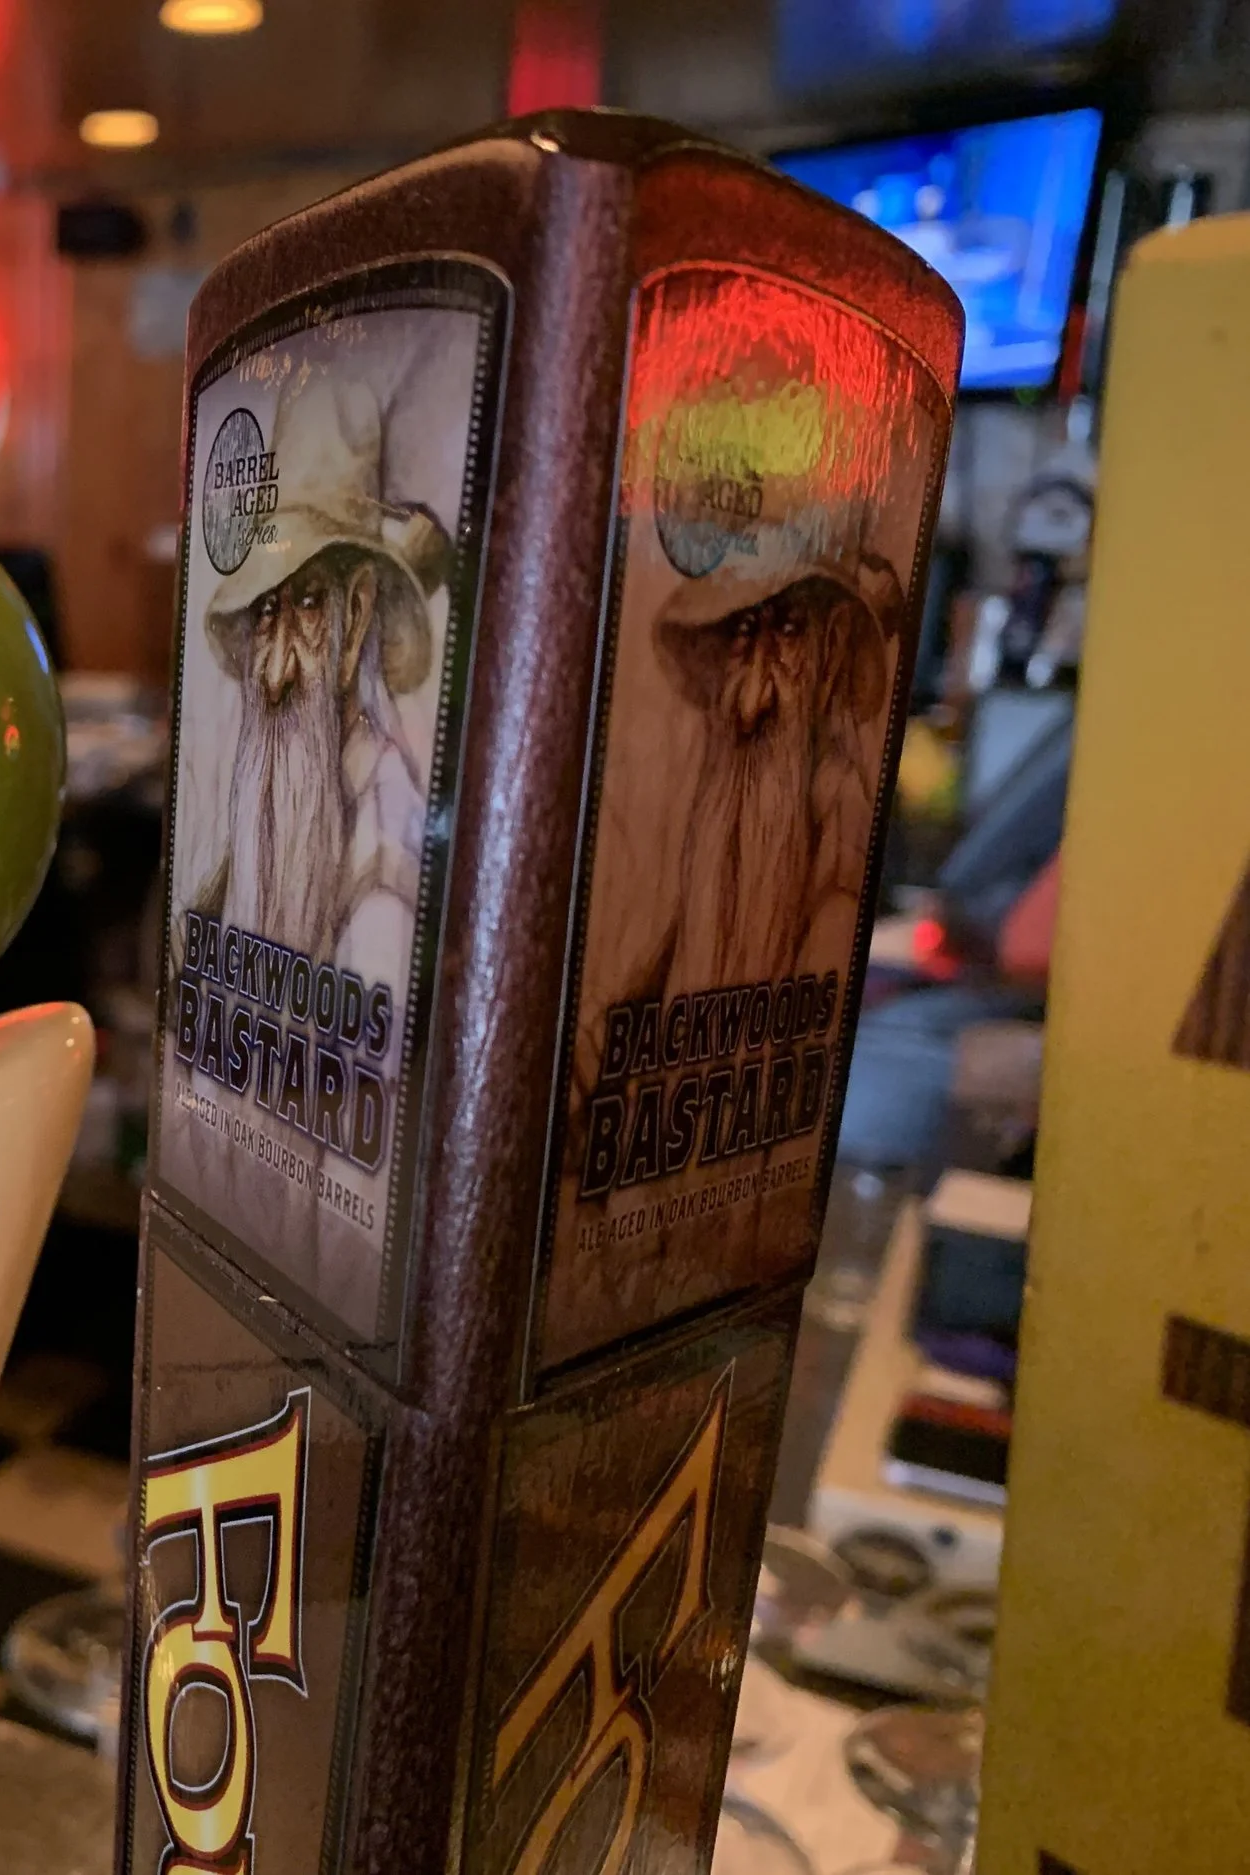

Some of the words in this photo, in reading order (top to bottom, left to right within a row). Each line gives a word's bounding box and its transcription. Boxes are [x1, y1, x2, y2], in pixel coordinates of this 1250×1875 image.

[214, 451, 280, 490] BARREL
[231, 483, 279, 518] AGED
[183, 910, 393, 1062] BACKWOODS
[601, 970, 838, 1081] BACKWOODS
[175, 979, 388, 1173] BASTARD
[579, 1048, 829, 1199] BASTARD
[220, 1107, 231, 1138] IN
[233, 1117, 256, 1153] OAK
[258, 1133, 314, 1190] BOURBON
[317, 1171, 375, 1230] BARRELS
[607, 1207, 646, 1244] AGED
[649, 1201, 666, 1229] IN
[668, 1191, 698, 1226] OAK
[699, 1172, 760, 1215] BOURBON
[761, 1155, 812, 1193] BARRELS
